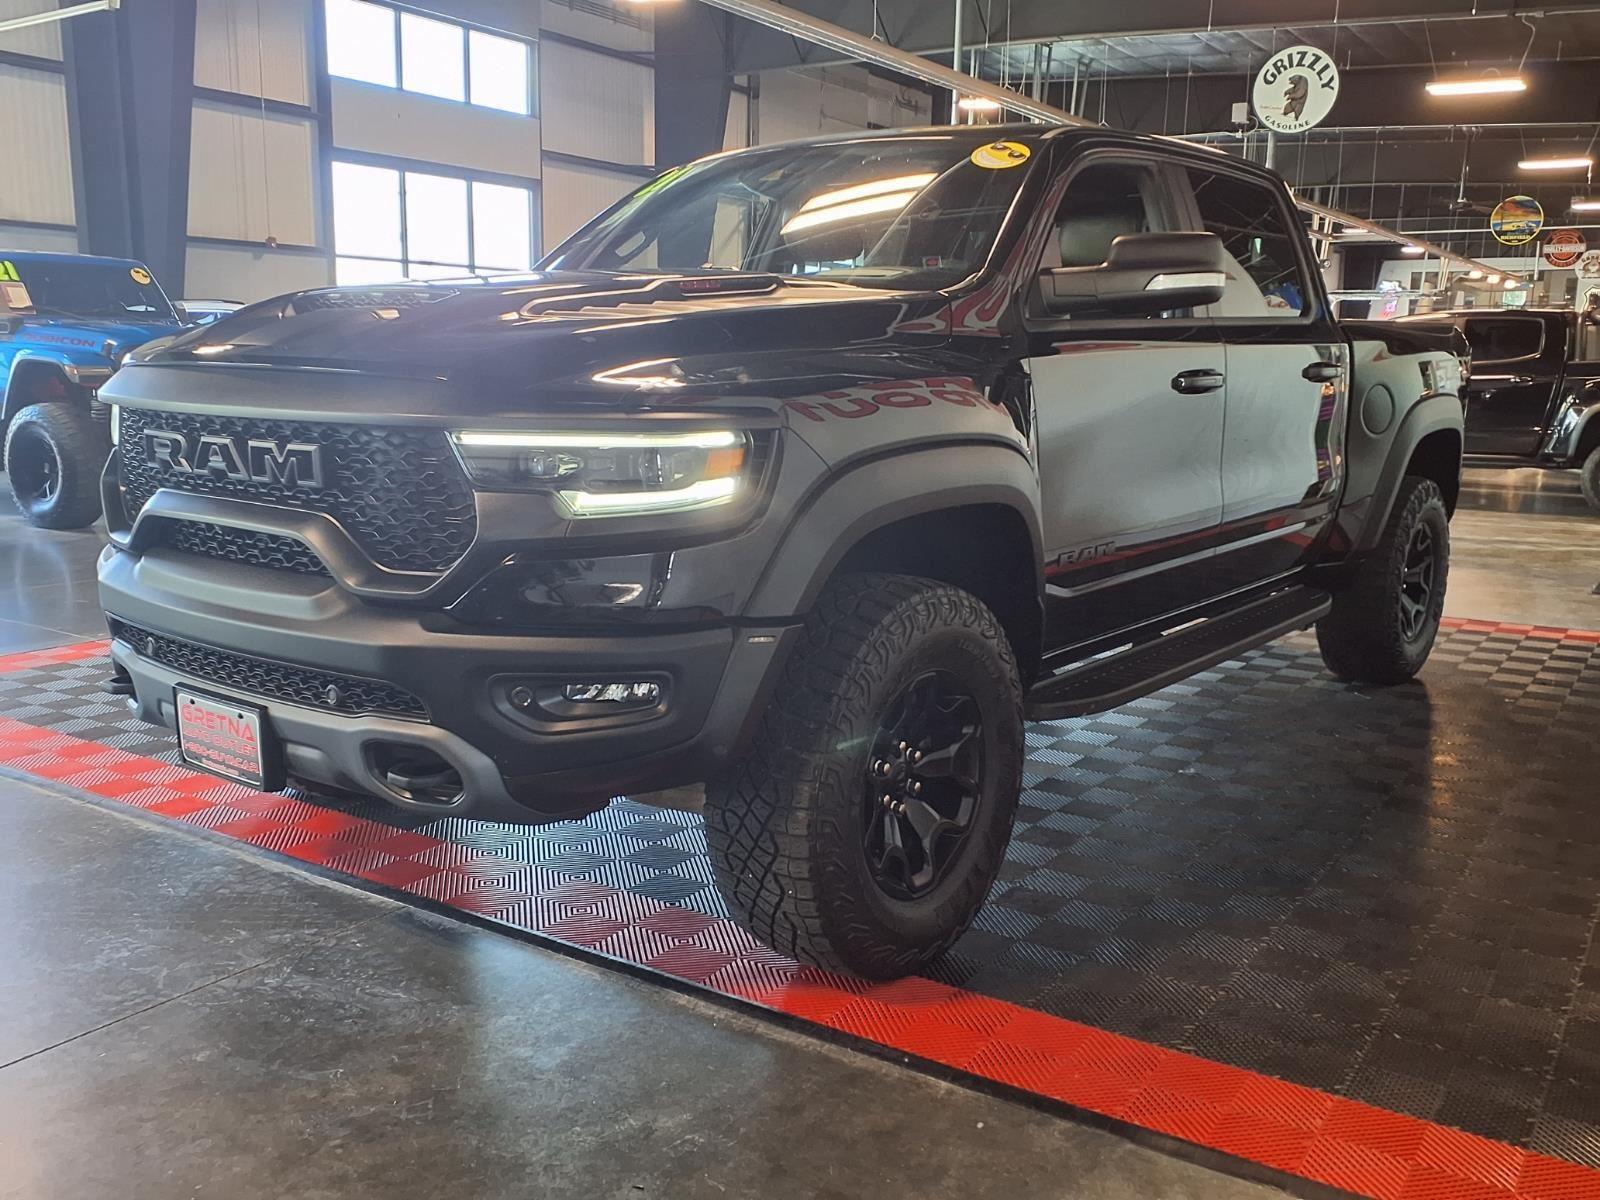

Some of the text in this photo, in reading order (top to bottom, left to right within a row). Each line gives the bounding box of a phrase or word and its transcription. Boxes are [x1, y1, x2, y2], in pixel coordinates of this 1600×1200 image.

[1263, 51, 1335, 91] GRIZZLY
[1264, 115, 1311, 130] GASOLINE
[143, 429, 323, 488] RAM
[1057, 541, 1116, 567] RAM
[182, 703, 256, 742] GRETNA
[213, 735, 257, 755] OUTLET
